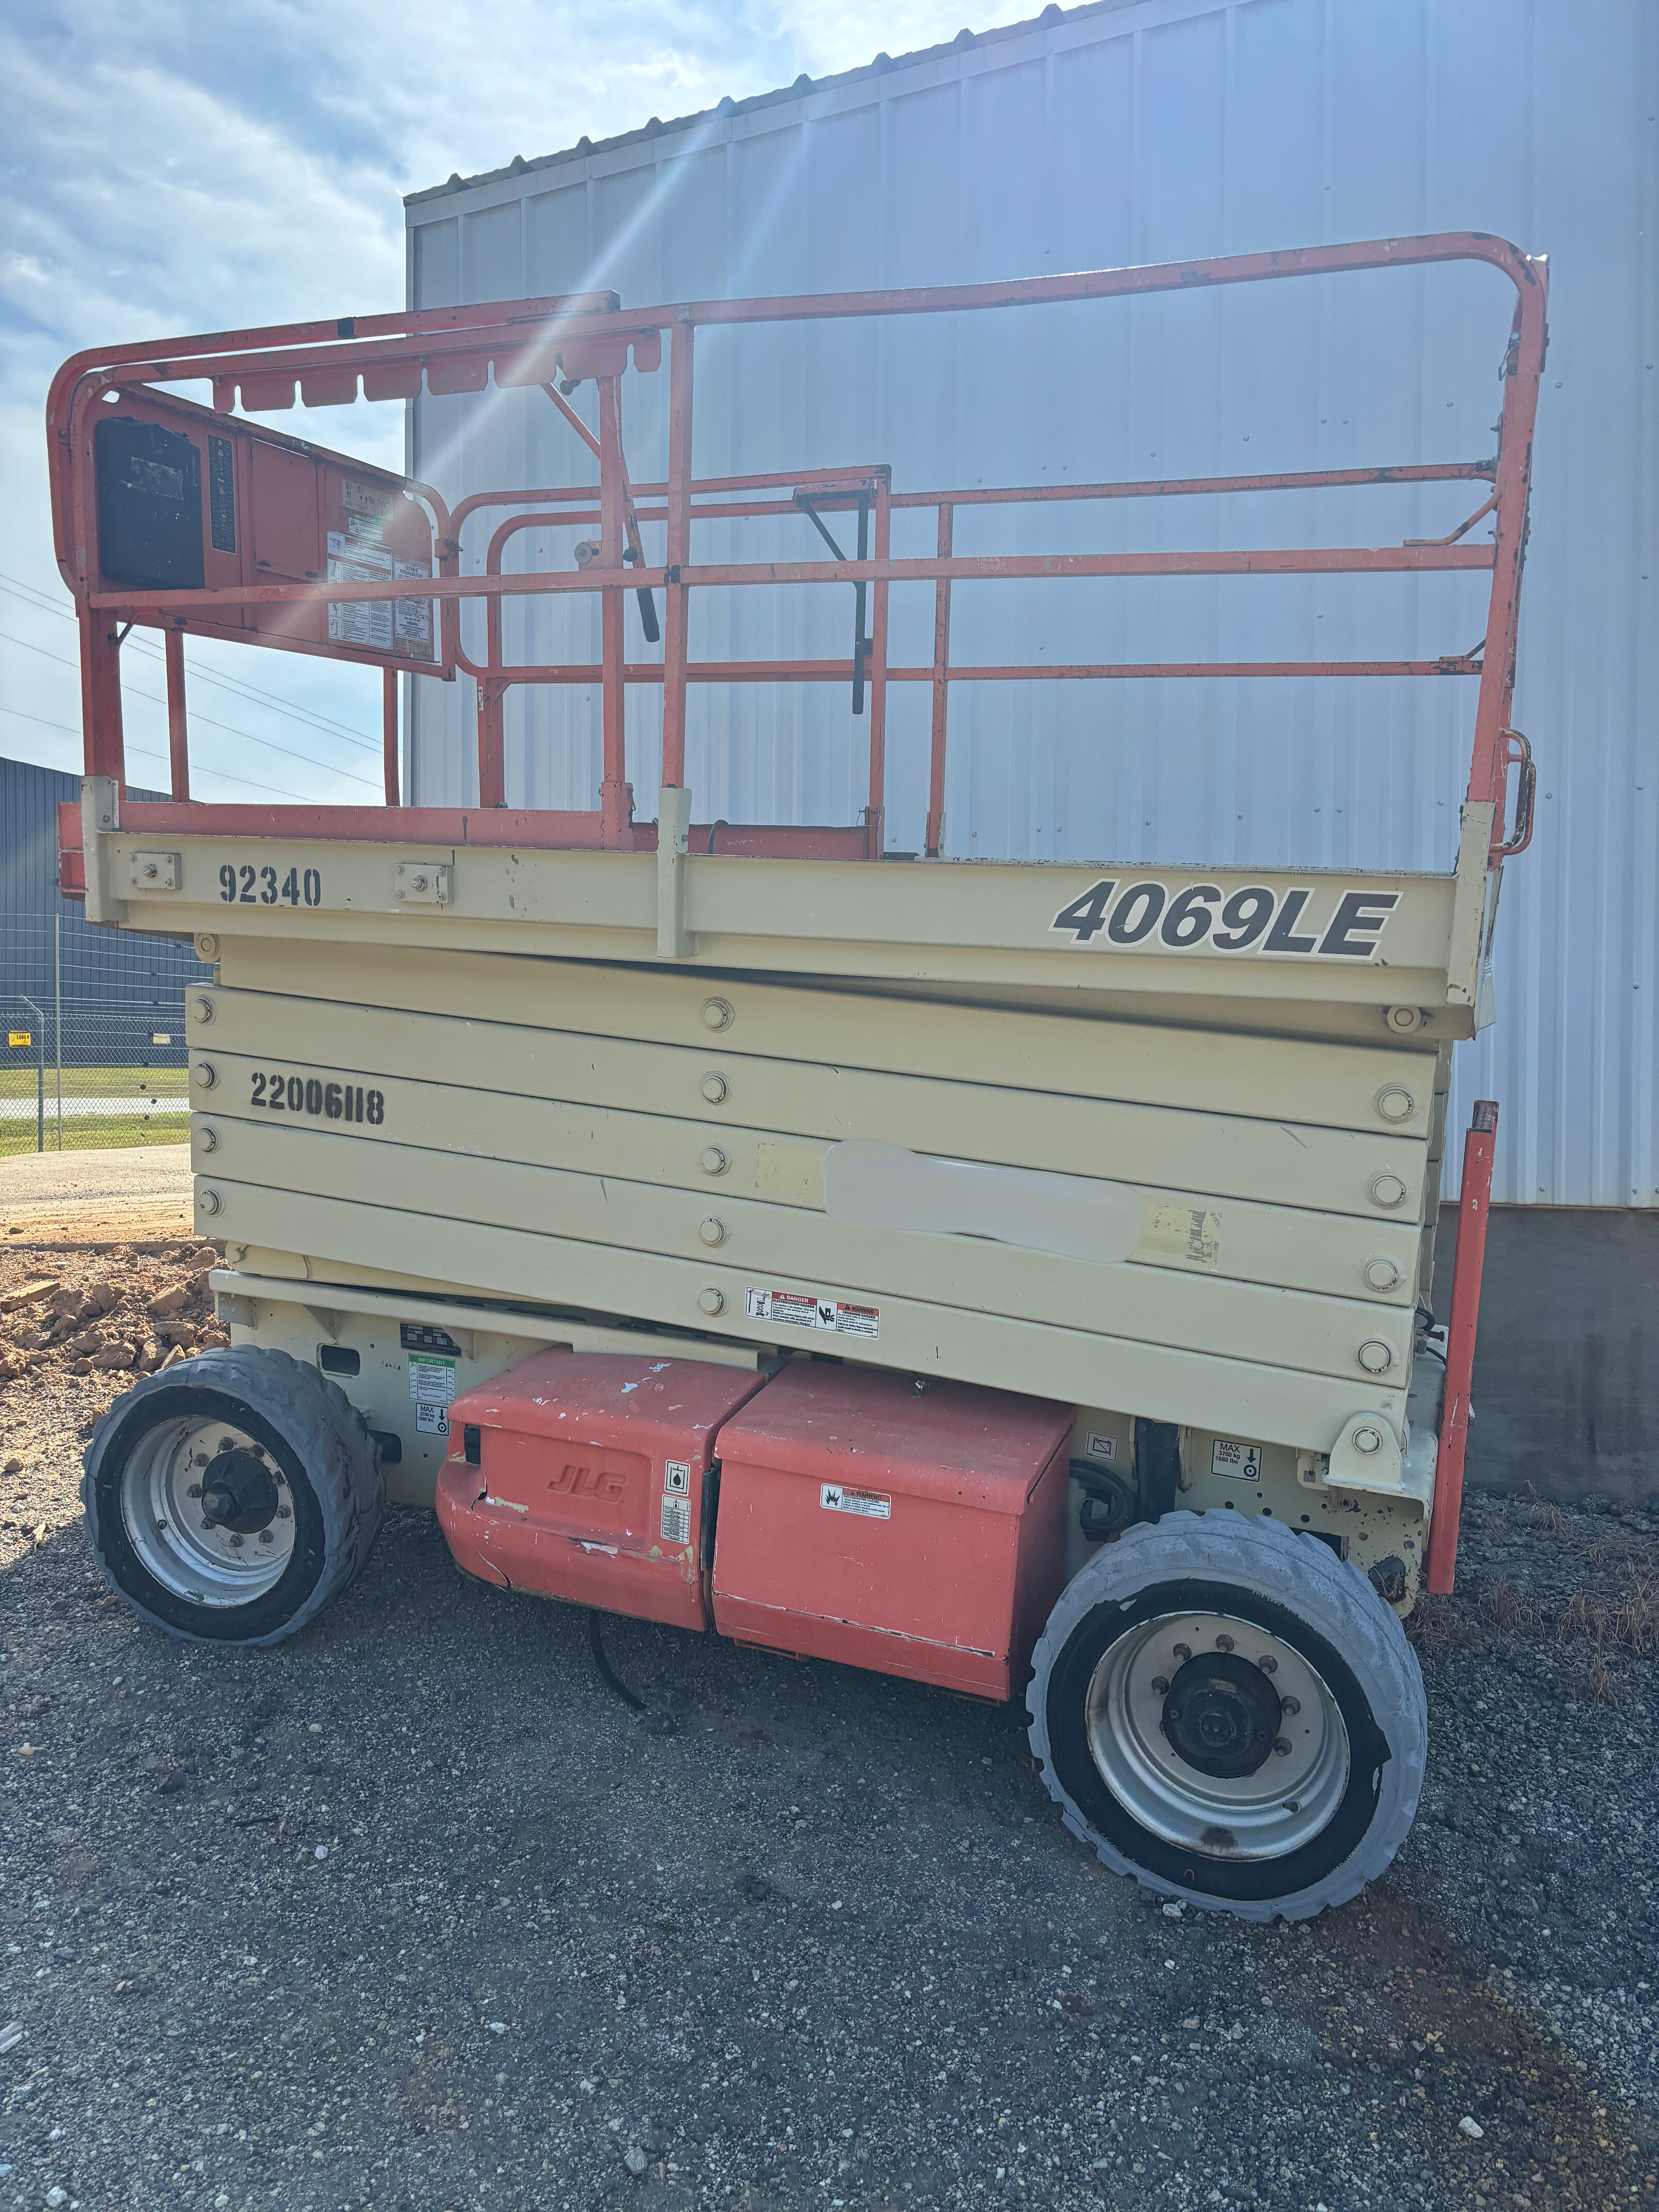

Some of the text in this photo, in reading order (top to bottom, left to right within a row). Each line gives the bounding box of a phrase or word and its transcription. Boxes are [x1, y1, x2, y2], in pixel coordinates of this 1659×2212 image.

[219, 865, 321, 906] 92340
[1051, 880, 1401, 956] 4069LE
[251, 1072, 384, 1125] 22006118
[786, 1295, 809, 1303] DANGER
[851, 1306, 874, 1314] WARNING
[418, 1357, 445, 1365] IMPORTANT
[420, 1405, 434, 1413] MAX
[1220, 1443, 1240, 1453] MAX
[548, 1464, 626, 1503] JLG
